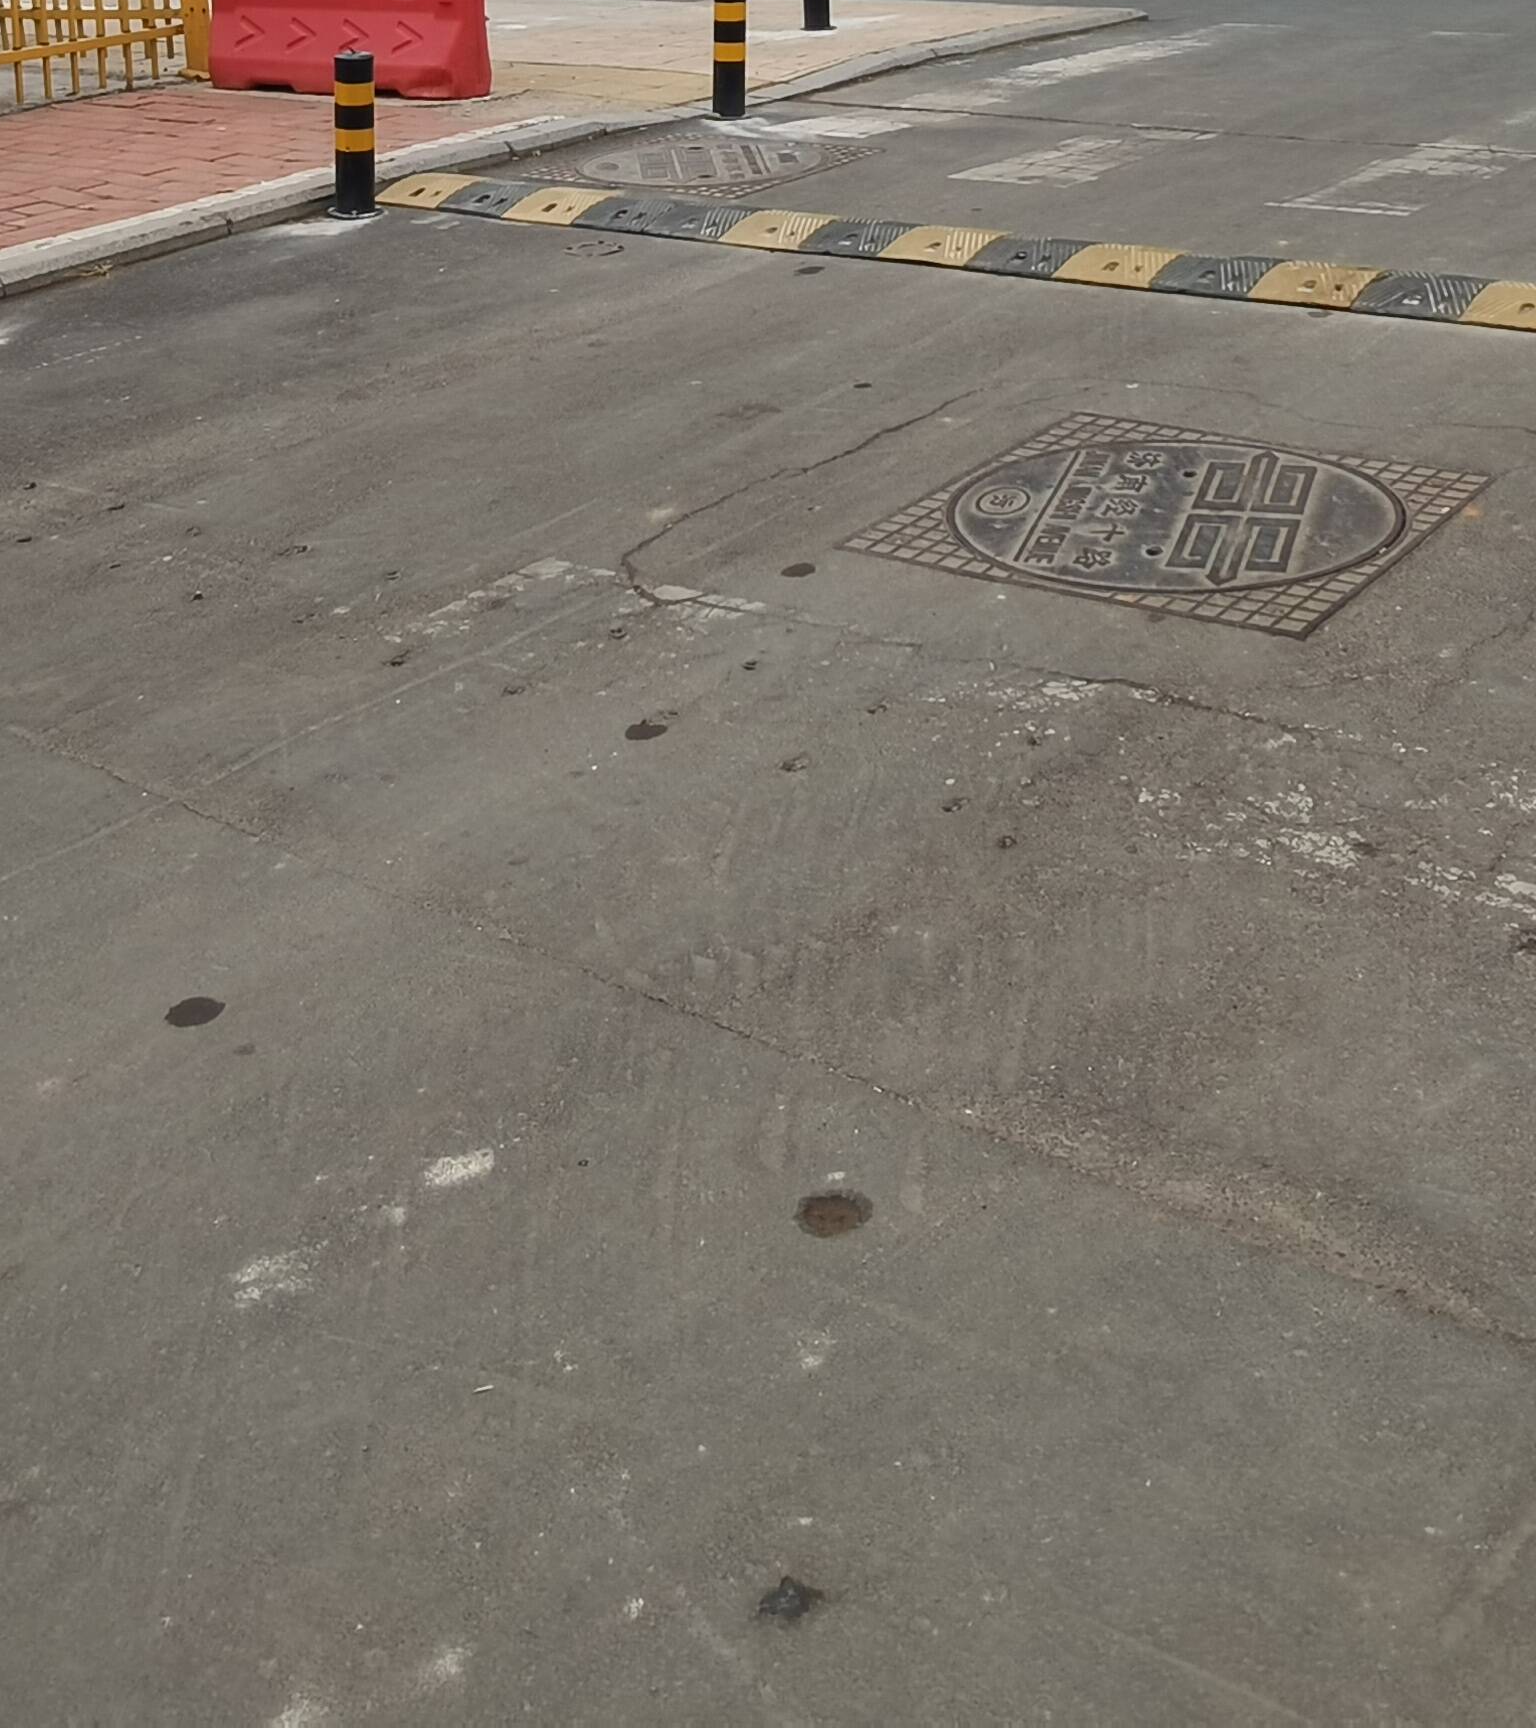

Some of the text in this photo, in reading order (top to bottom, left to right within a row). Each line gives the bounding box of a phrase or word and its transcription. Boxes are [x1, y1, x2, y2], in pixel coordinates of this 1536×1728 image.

[1072, 451, 1163, 570] 济南经十路
